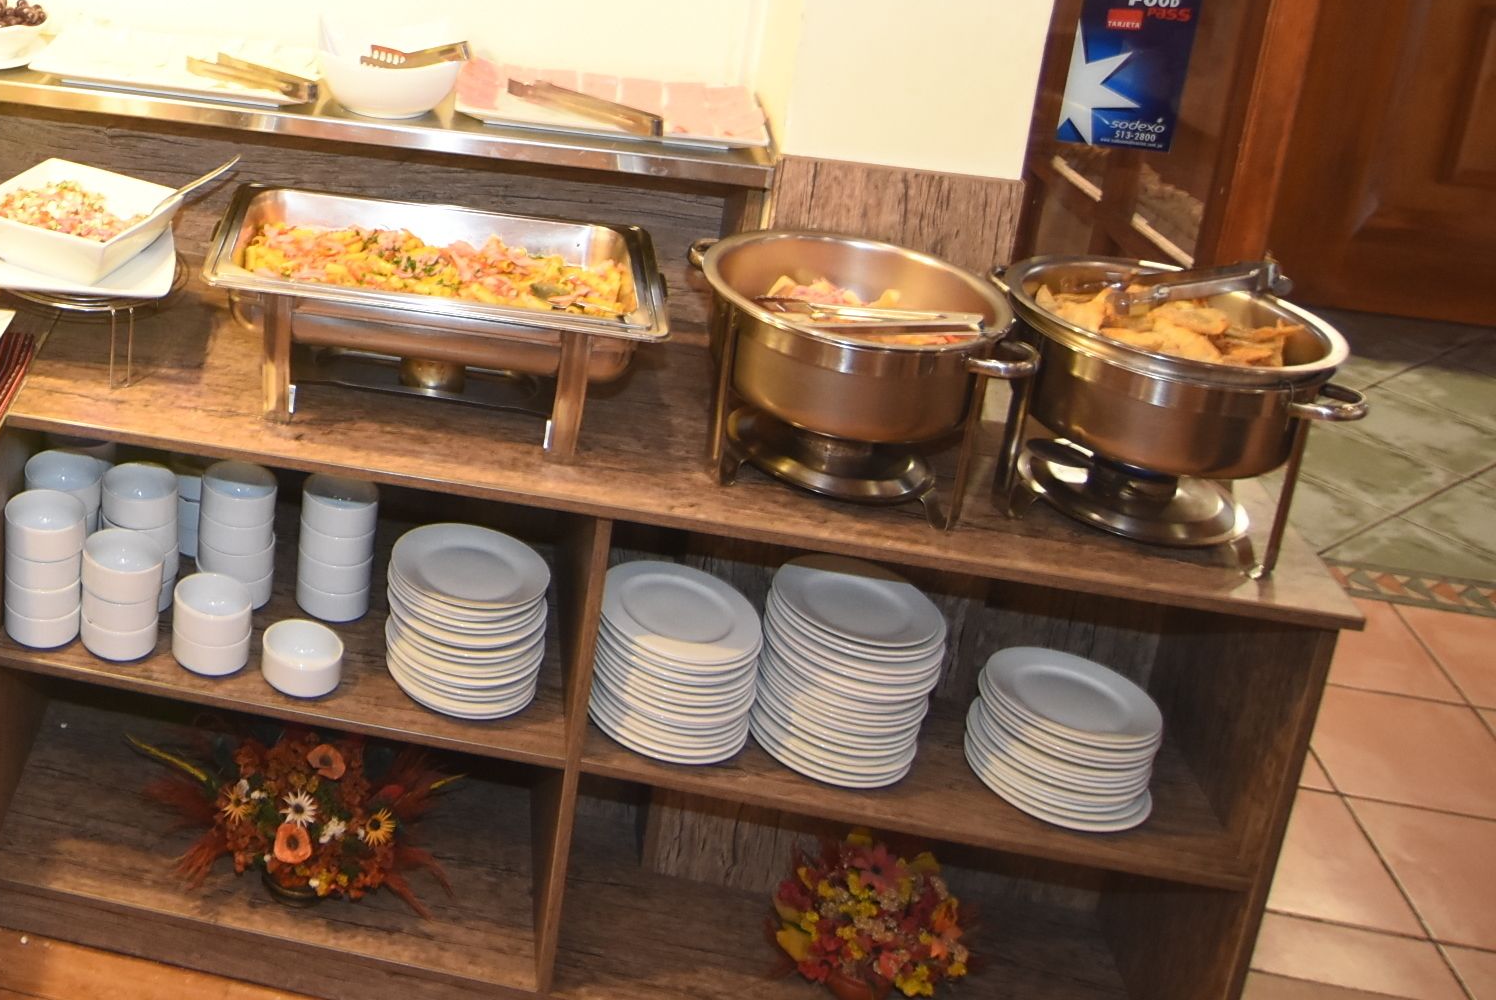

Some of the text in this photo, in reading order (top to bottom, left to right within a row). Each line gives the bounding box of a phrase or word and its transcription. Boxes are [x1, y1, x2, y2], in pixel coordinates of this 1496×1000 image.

[1107, 21, 1141, 29] TARJETA
[1109, 119, 1164, 133] sodexo
[1115, 130, 1156, 142] 513-2800
